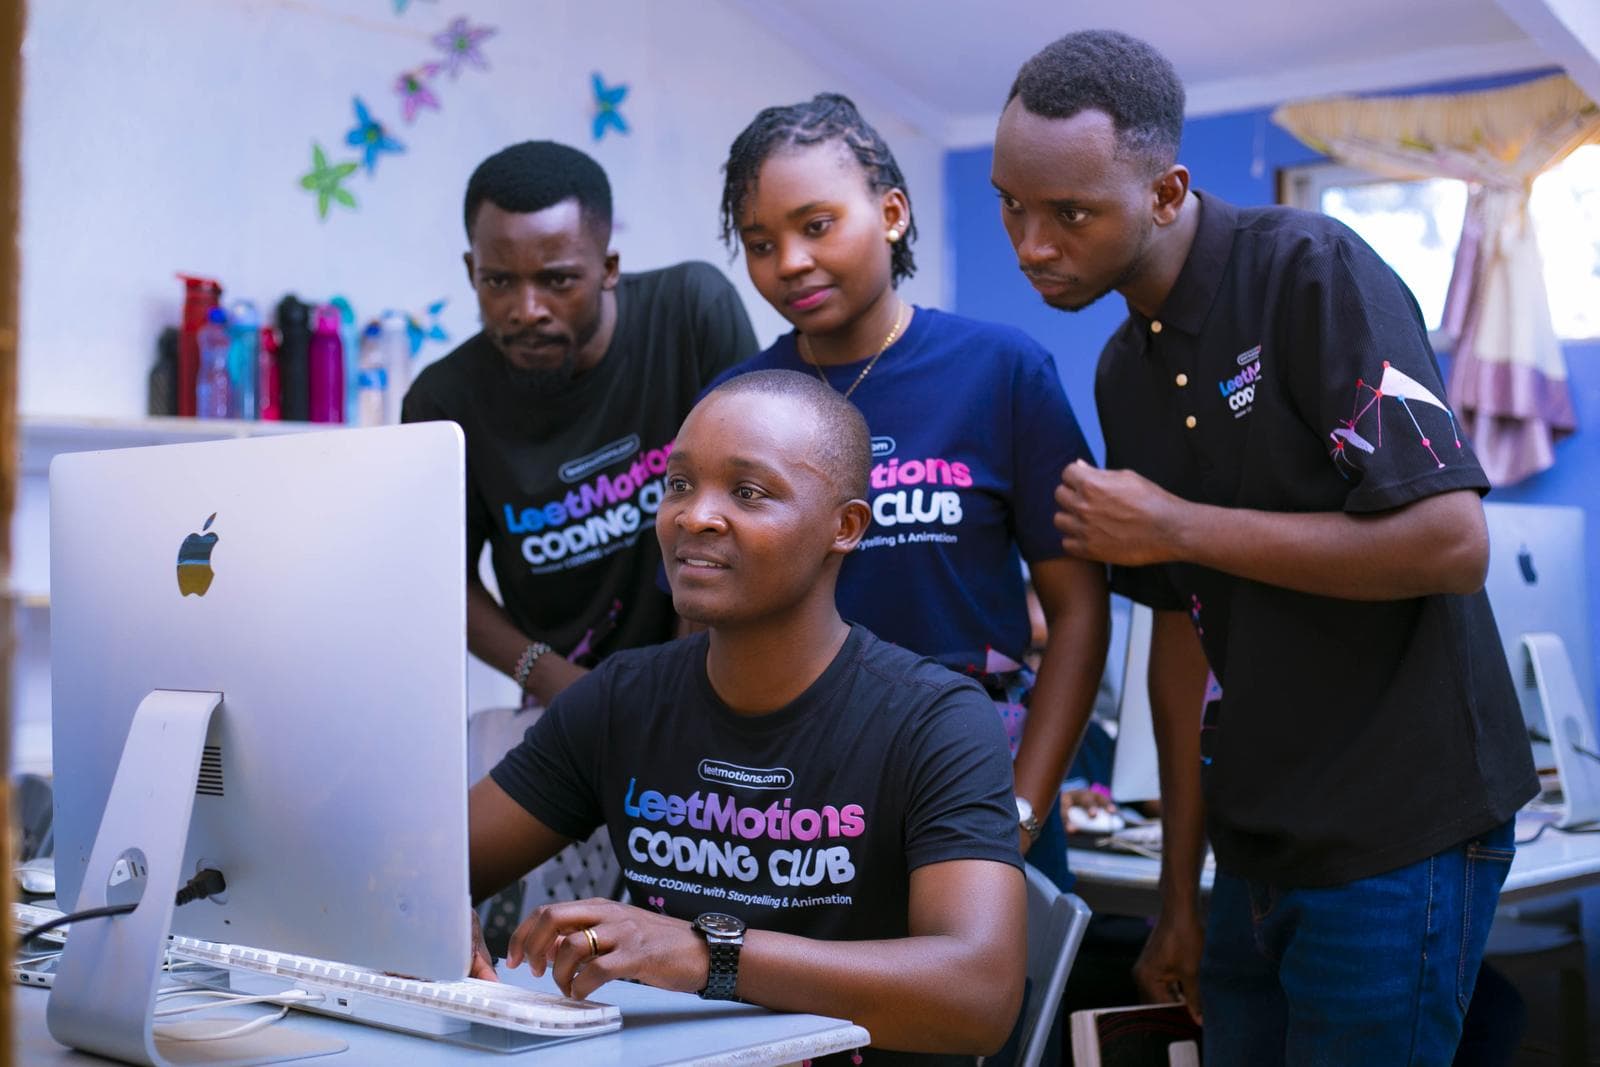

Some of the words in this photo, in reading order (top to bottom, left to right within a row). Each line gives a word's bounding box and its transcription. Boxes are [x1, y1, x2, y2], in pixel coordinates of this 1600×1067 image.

[1219, 358, 1262, 397] LeetM
[1229, 384, 1256, 410] COD
[872, 488, 963, 526] CLUB
[521, 502, 641, 565] CODING
[703, 763, 786, 784] leetmotions.com
[624, 777, 865, 841] LeetMotions
[627, 826, 759, 882] CODING
[768, 846, 856, 886] CLUB
[624, 868, 658, 885] Master
[658, 878, 702, 894] CODING
[703, 886, 726, 899] with
[727, 890, 781, 909] Storytelling
[781, 897, 789, 908] &
[791, 893, 853, 908] Animation
